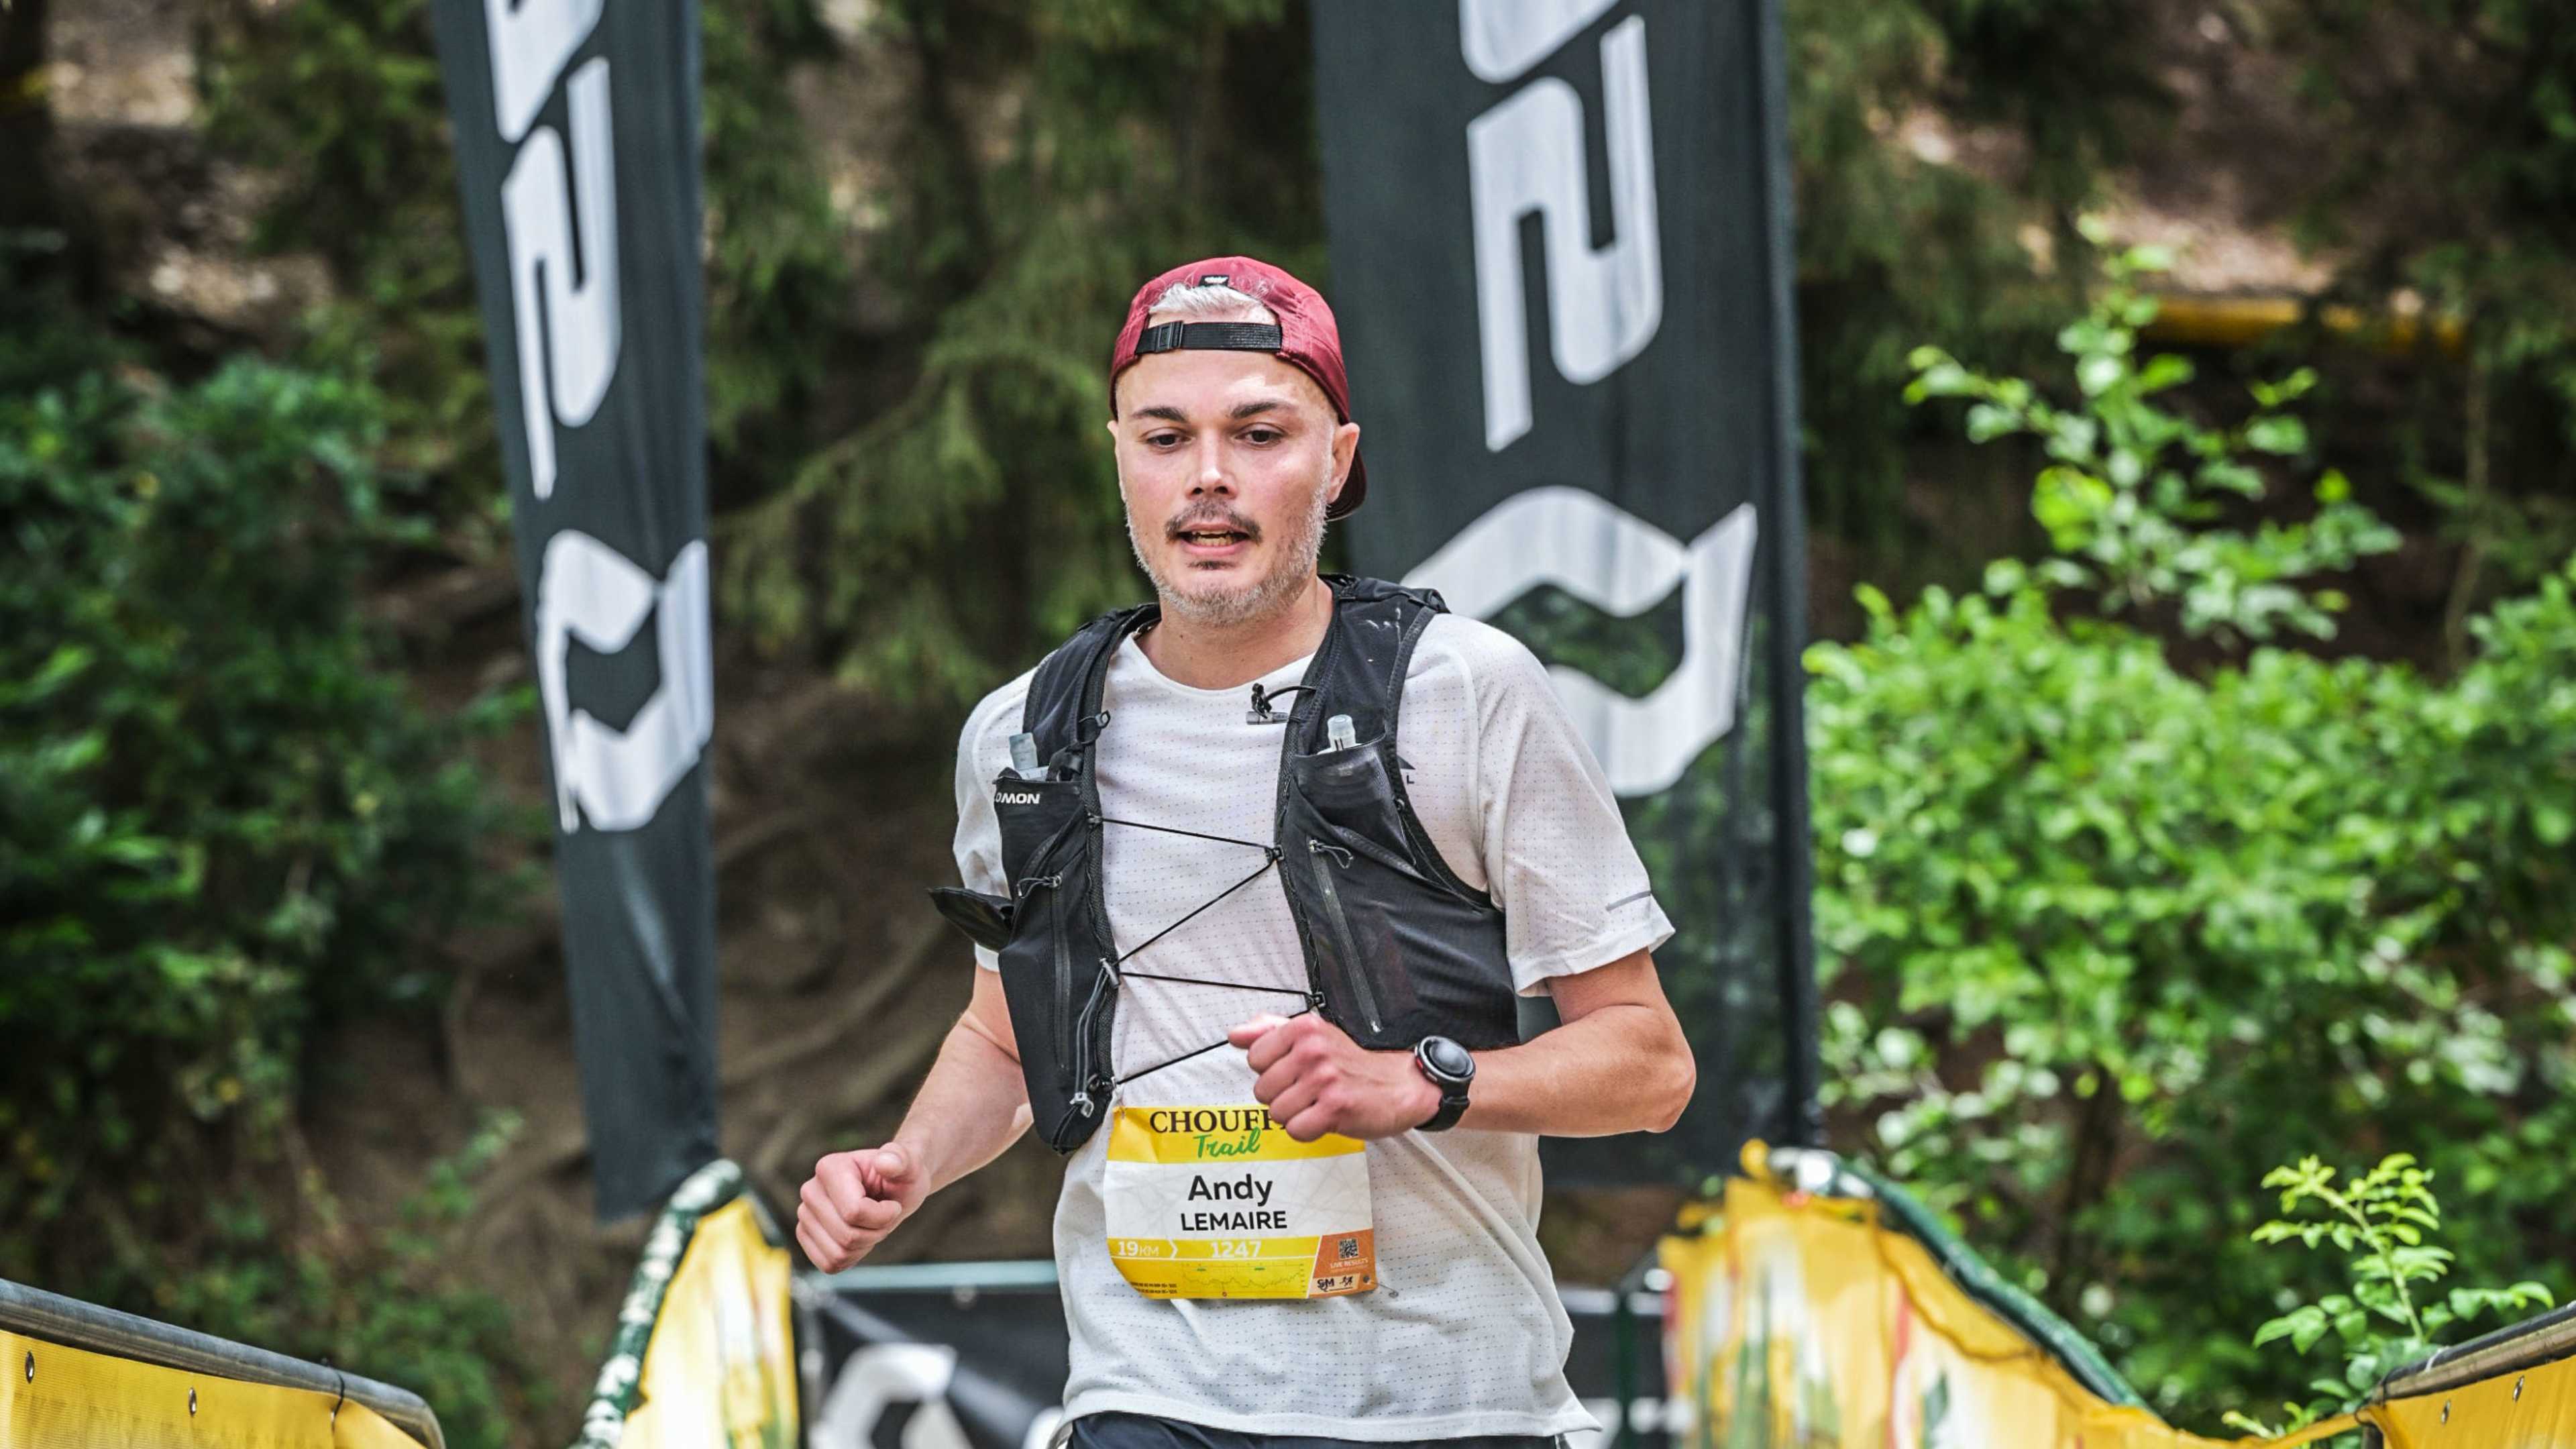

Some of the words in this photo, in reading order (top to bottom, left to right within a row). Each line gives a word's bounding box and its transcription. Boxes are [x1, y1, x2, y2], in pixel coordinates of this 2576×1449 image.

[995, 792, 1040, 804] OMON
[1150, 1109, 1286, 1133] CHOUFF
[1193, 1126, 1261, 1159] Trail
[1188, 1174, 1273, 1206] Andy
[1181, 1210, 1288, 1232] LEMAIRE
[1210, 1240, 1262, 1258] 1247
